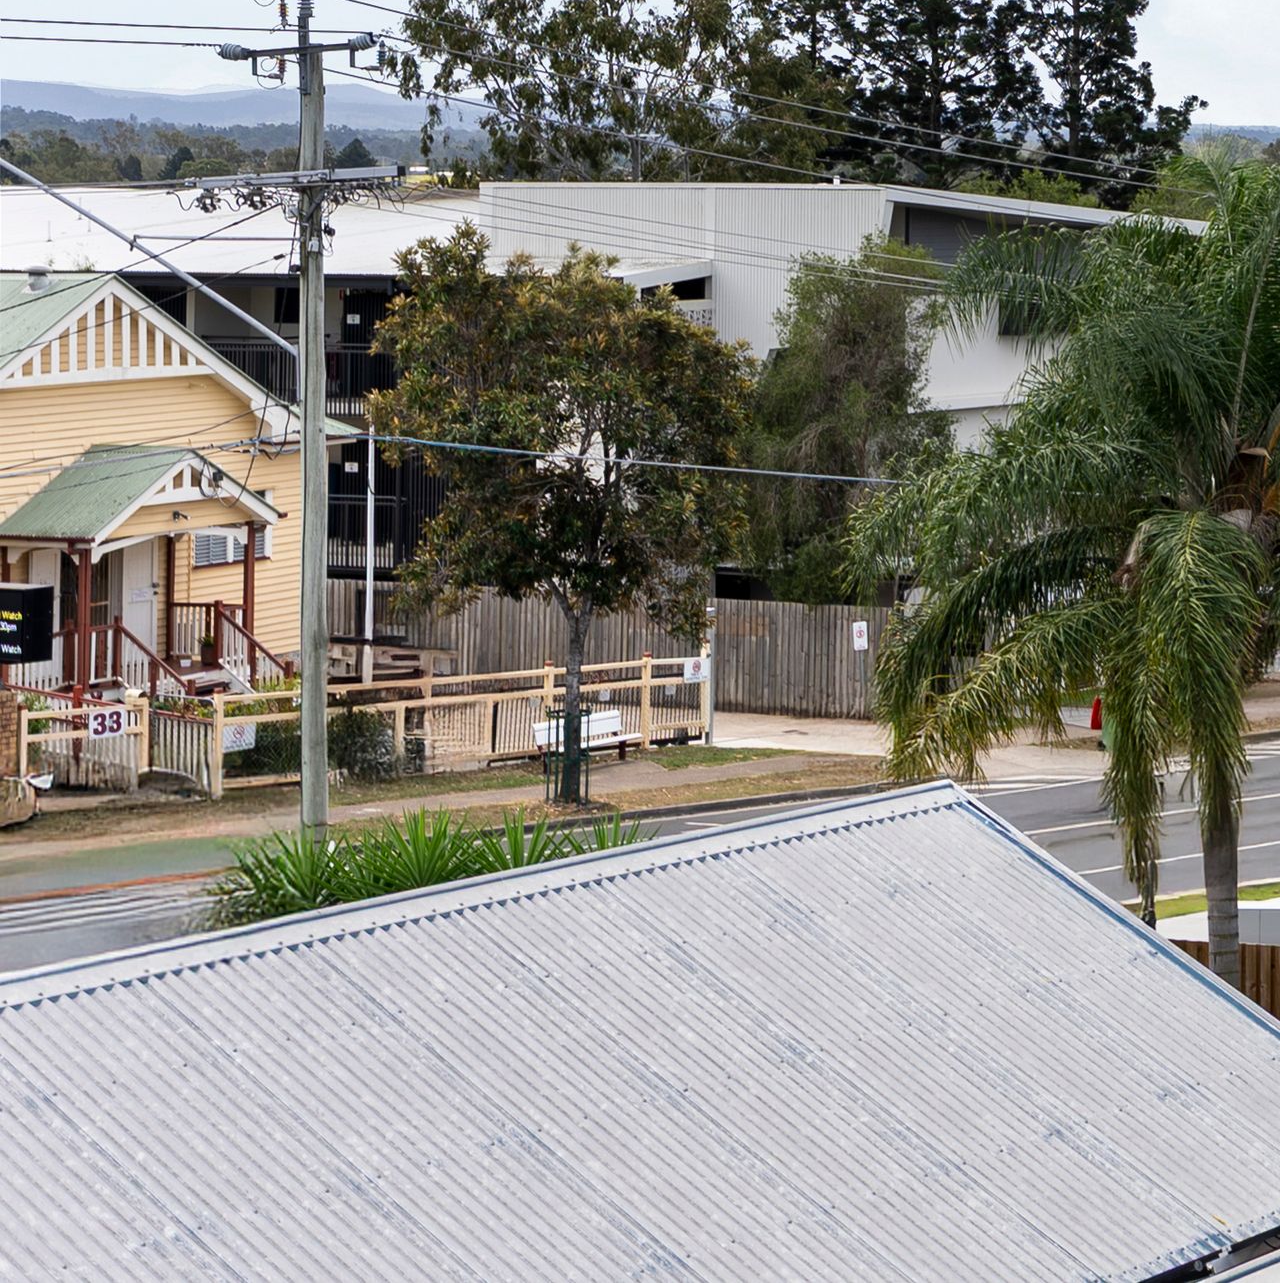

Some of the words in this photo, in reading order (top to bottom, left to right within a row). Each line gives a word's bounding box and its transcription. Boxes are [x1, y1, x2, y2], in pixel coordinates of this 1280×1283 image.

[2, 610, 23, 621] Watch
[1, 644, 22, 655] Watch
[93, 710, 122, 735] 33
